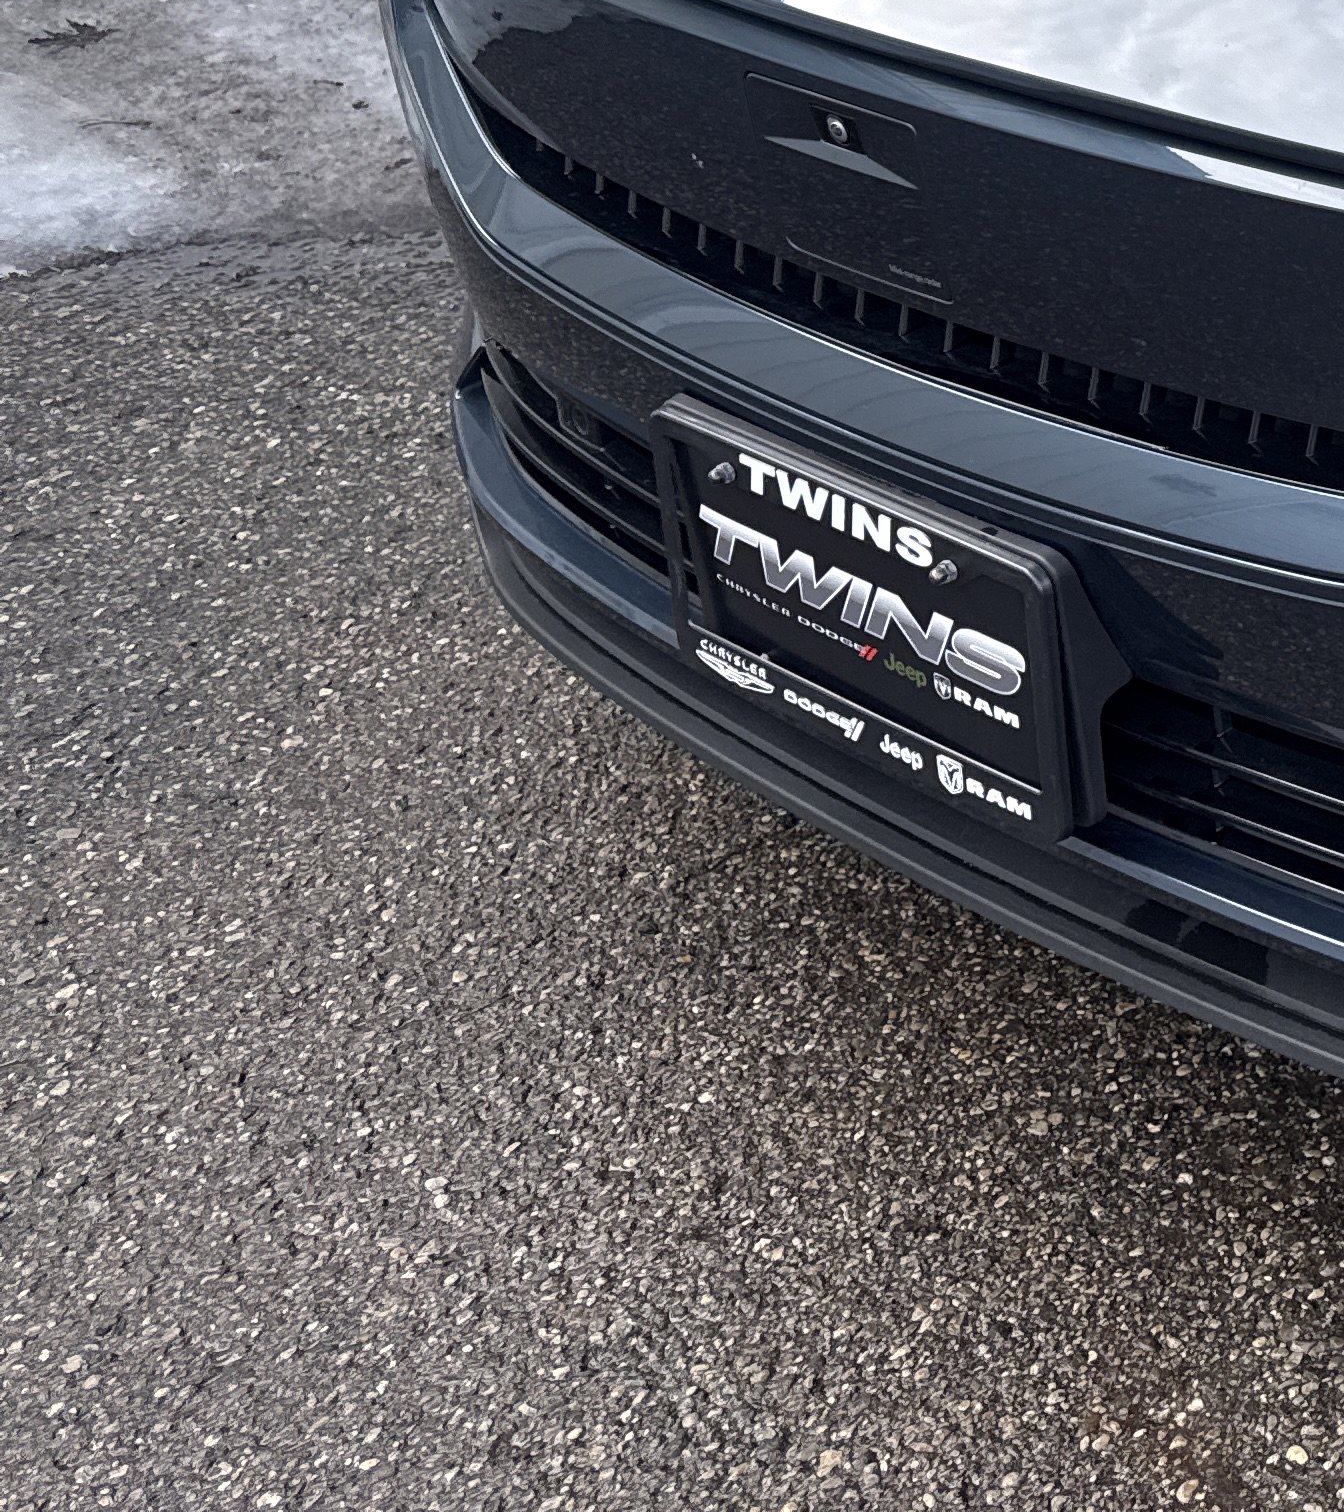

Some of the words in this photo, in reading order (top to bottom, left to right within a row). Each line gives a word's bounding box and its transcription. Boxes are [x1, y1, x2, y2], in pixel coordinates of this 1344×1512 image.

[739, 452, 935, 568] TWINS
[699, 503, 1027, 696] TWINS
[716, 573, 791, 619] CHRYSLER
[797, 615, 866, 653] DODGE
[883, 652, 928, 689] Jeep
[953, 686, 1021, 730] RAM
[700, 638, 767, 681] CHRYSLER
[783, 688, 858, 732] DODGE
[879, 733, 924, 772] Jeep
[965, 777, 1033, 822] RAM
